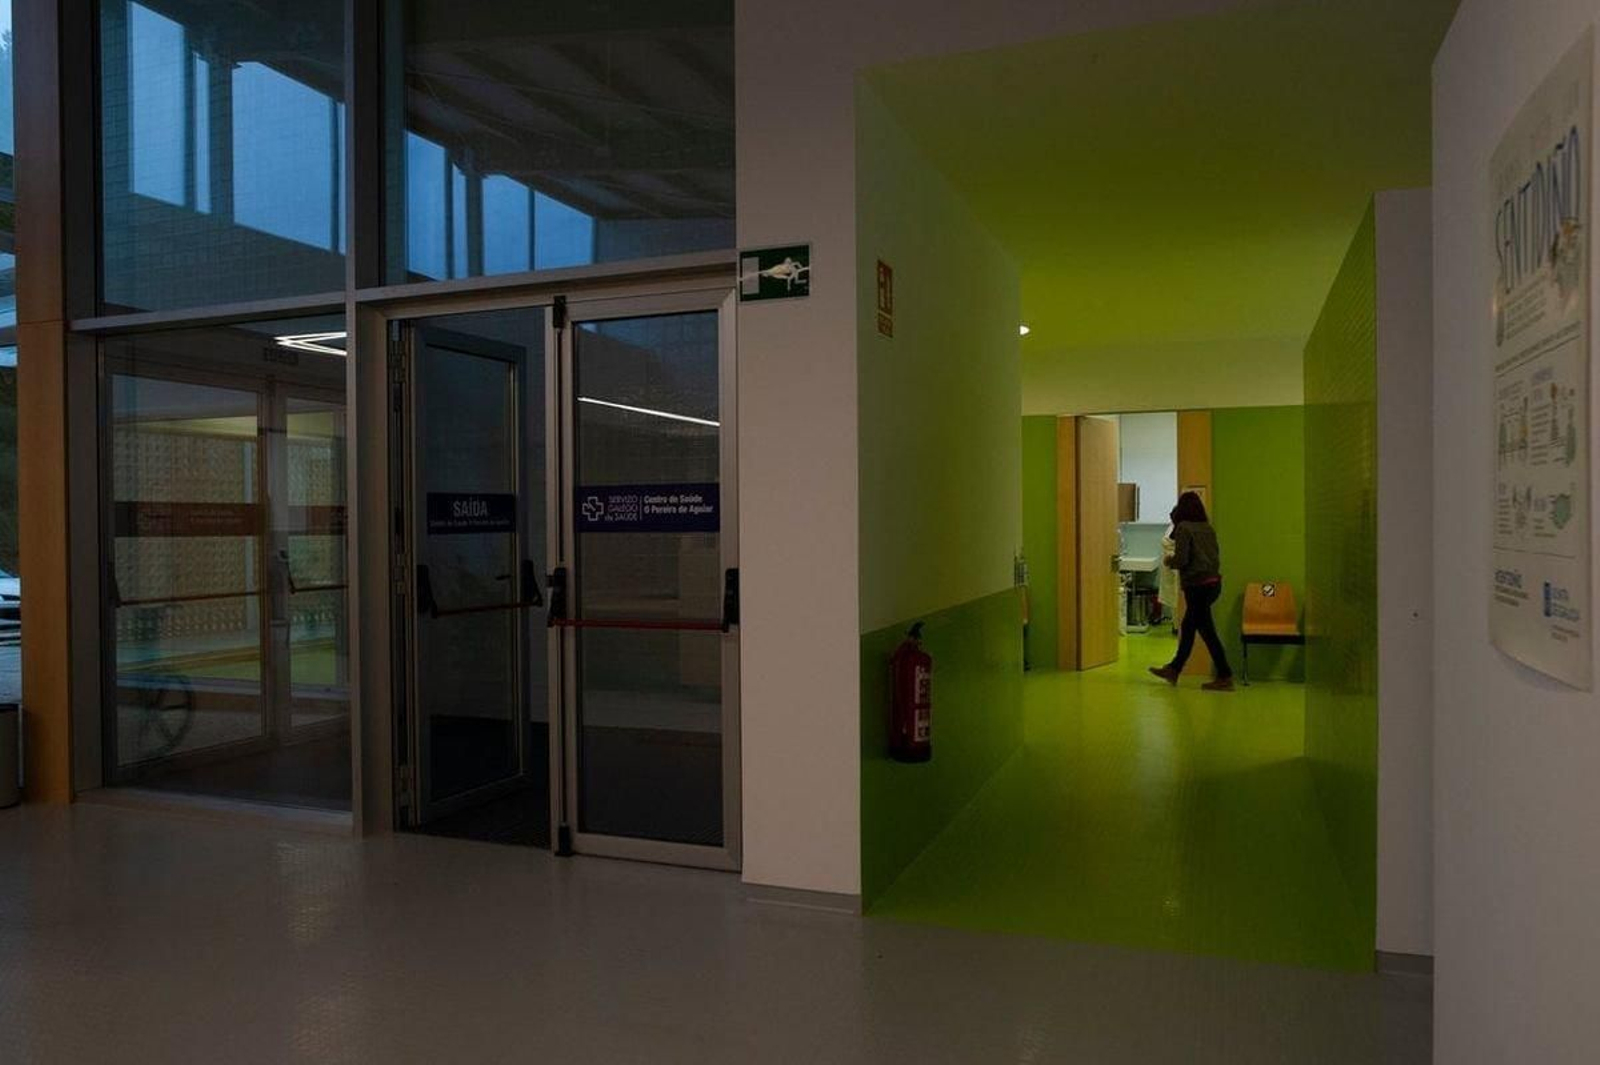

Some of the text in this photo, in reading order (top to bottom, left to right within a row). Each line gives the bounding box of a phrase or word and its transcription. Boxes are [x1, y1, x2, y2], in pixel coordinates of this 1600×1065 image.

[643, 494, 703, 504] Centro de Saúde
[452, 496, 488, 517] SAÍDA
[678, 504, 688, 514] de
[689, 503, 714, 515] Aguiar
